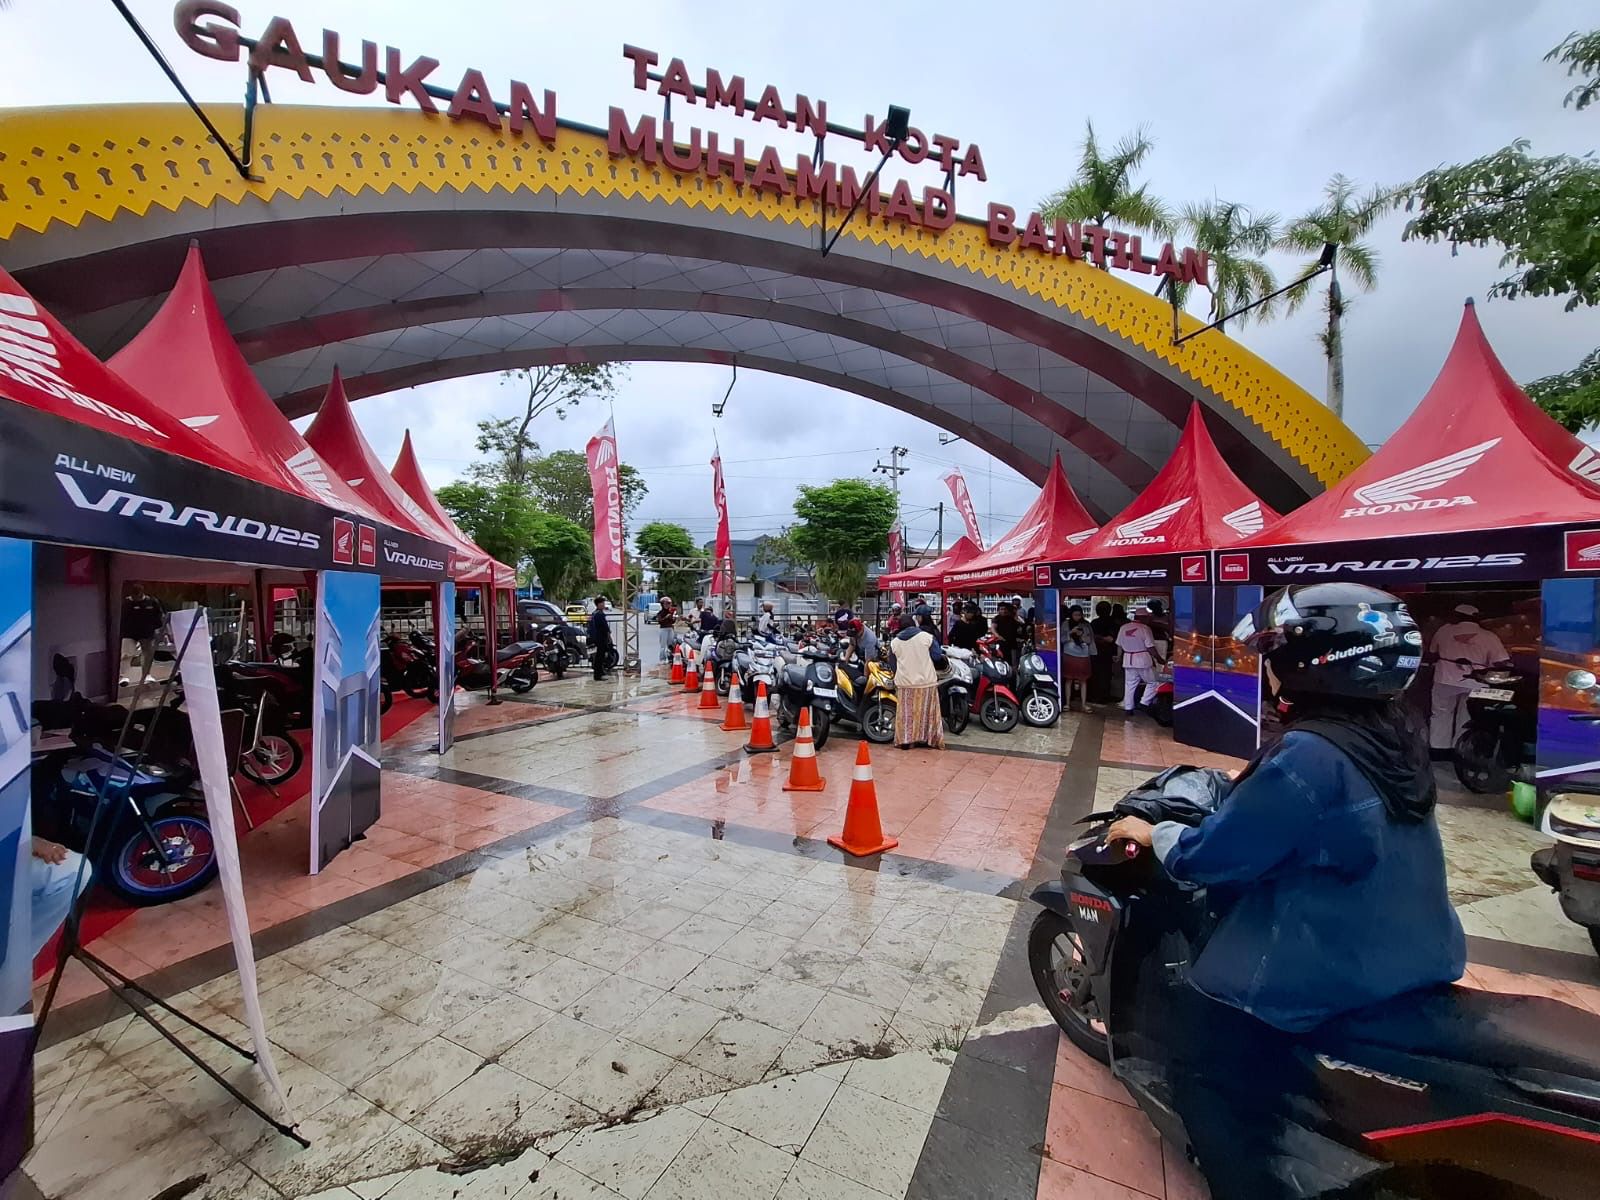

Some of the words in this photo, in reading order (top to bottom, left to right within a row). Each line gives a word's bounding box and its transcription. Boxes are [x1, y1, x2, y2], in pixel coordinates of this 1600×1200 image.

[174, 0, 557, 142] GAUKAN
[607, 105, 957, 231] MUHAMMAD
[987, 202, 1209, 286] BANTILAN
[623, 43, 827, 138] TAMAN
[864, 113, 987, 182] KOTA
[55, 453, 95, 475] ALL
[96, 463, 137, 484] NEW
[605, 465, 622, 565] HONDA
[1340, 495, 1478, 519] HONDA
[1103, 535, 1166, 547] HONDA
